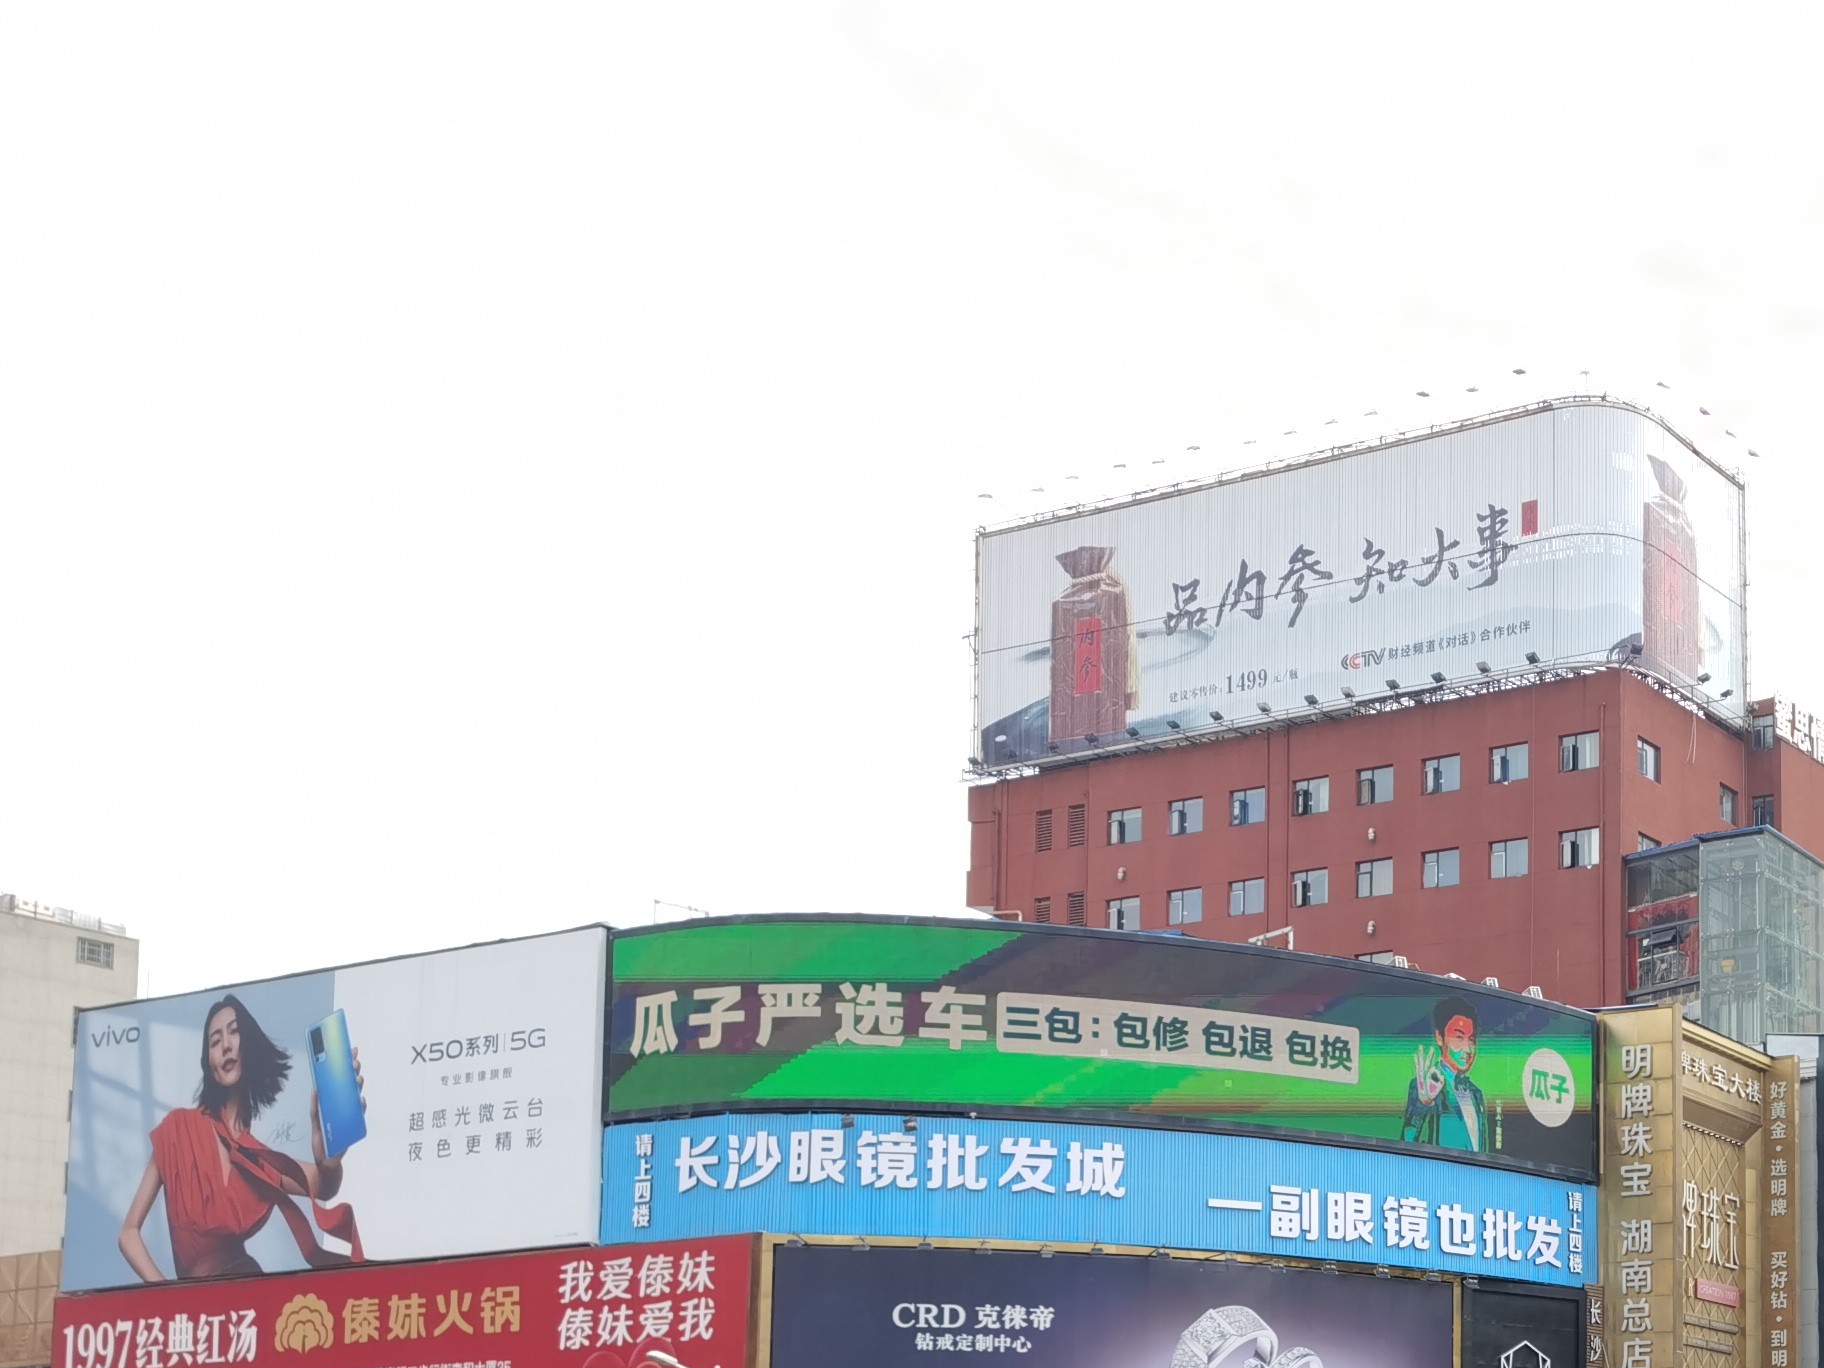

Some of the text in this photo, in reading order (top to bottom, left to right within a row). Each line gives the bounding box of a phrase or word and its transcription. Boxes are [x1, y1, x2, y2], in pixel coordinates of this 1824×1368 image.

[1349, 503, 1518, 603] 知大事
[1341, 647, 1387, 671] CCTV
[1225, 668, 1268, 695] 1499
[91, 1025, 141, 1048] vivo
[628, 980, 988, 1059] 瓜子严选车
[1201, 1020, 1273, 1062] 包退
[1286, 1027, 1352, 1072] 包换
[410, 1028, 546, 1065] X50系列 5G
[1529, 1068, 1570, 1105] 瓜子
[408, 1097, 543, 1132] 超感光微云台
[1620, 1043, 1655, 1200] 明牌珠宝
[408, 1127, 543, 1162] 夜色更精彩
[675, 1127, 1127, 1199] 长沙眼镜批发城
[633, 1133, 654, 1229] 请上四楼
[1207, 1184, 1563, 1269] 一副眼镜也批发
[1566, 1190, 1584, 1275] 请上四楼
[892, 1302, 1055, 1331] CRD 克徕帝
[914, 1333, 1033, 1354] 钻戒定制中心
